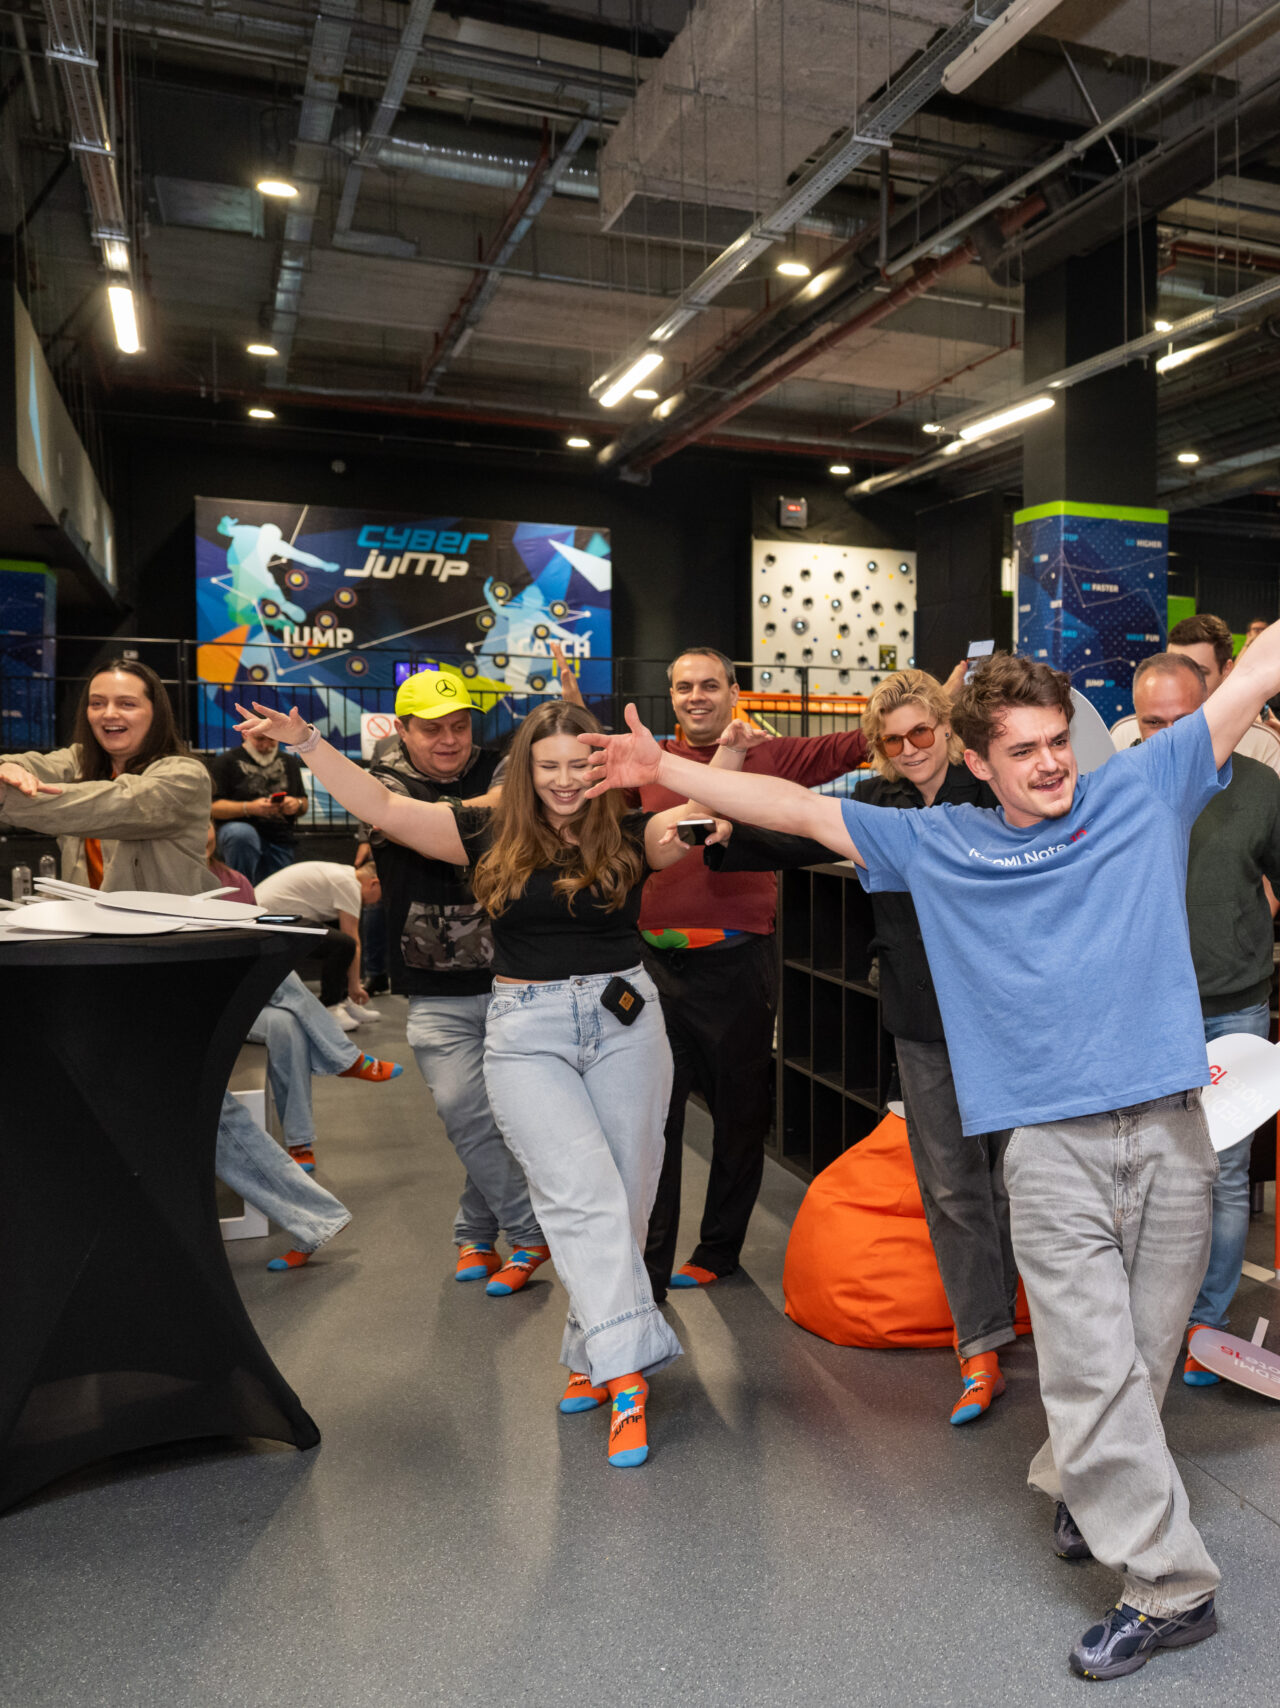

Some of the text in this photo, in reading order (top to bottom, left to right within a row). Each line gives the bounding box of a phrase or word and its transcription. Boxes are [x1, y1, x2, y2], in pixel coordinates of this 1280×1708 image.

[1136, 540, 1162, 548] HIGHER
[1092, 583, 1119, 592] FASTER
[283, 625, 354, 650] JUMP
[1145, 634, 1160, 642] FUN
[1085, 679, 1104, 688] JUMP
[1024, 843, 1067, 864] Note
[1220, 1345, 1242, 1360] 15
